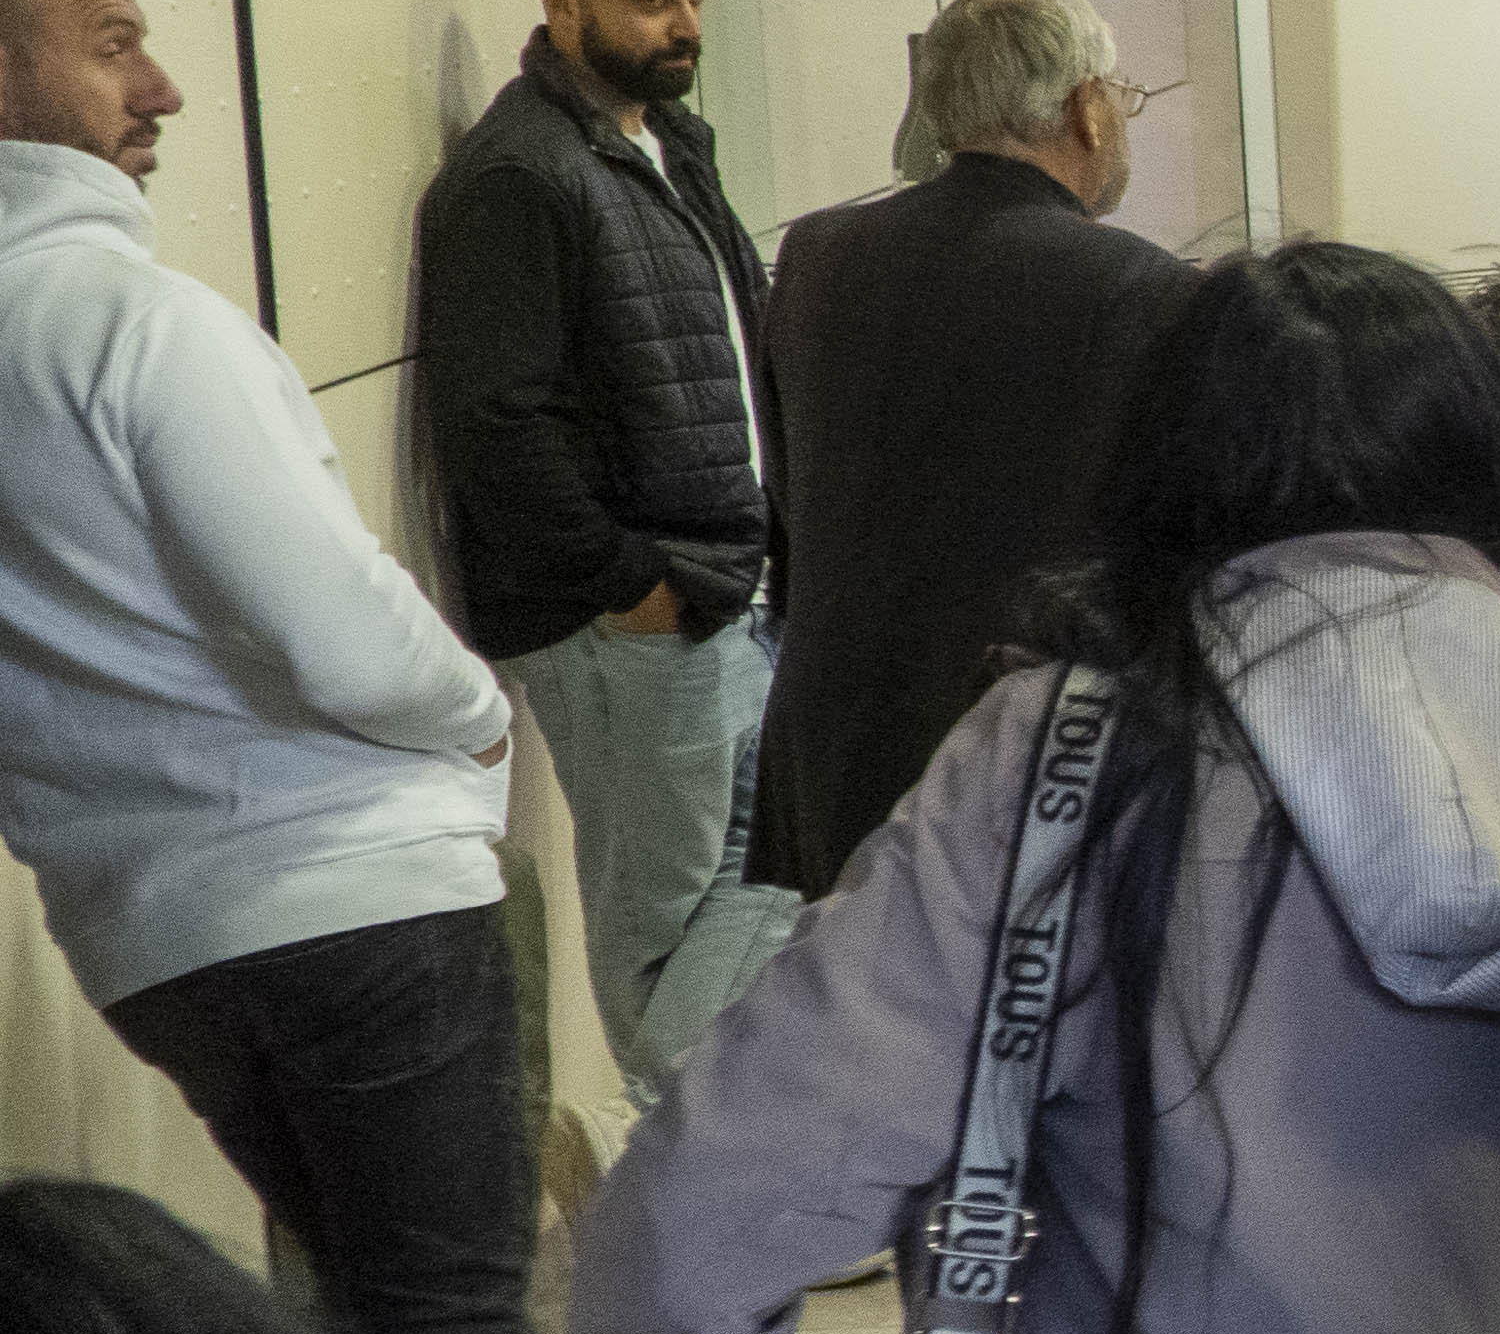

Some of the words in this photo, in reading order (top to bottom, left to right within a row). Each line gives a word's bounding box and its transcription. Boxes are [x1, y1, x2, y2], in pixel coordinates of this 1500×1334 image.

[1035, 693, 1115, 824] TOUS
[990, 918, 1060, 1062] TOUS
[947, 1158, 1017, 1298] TOUS
